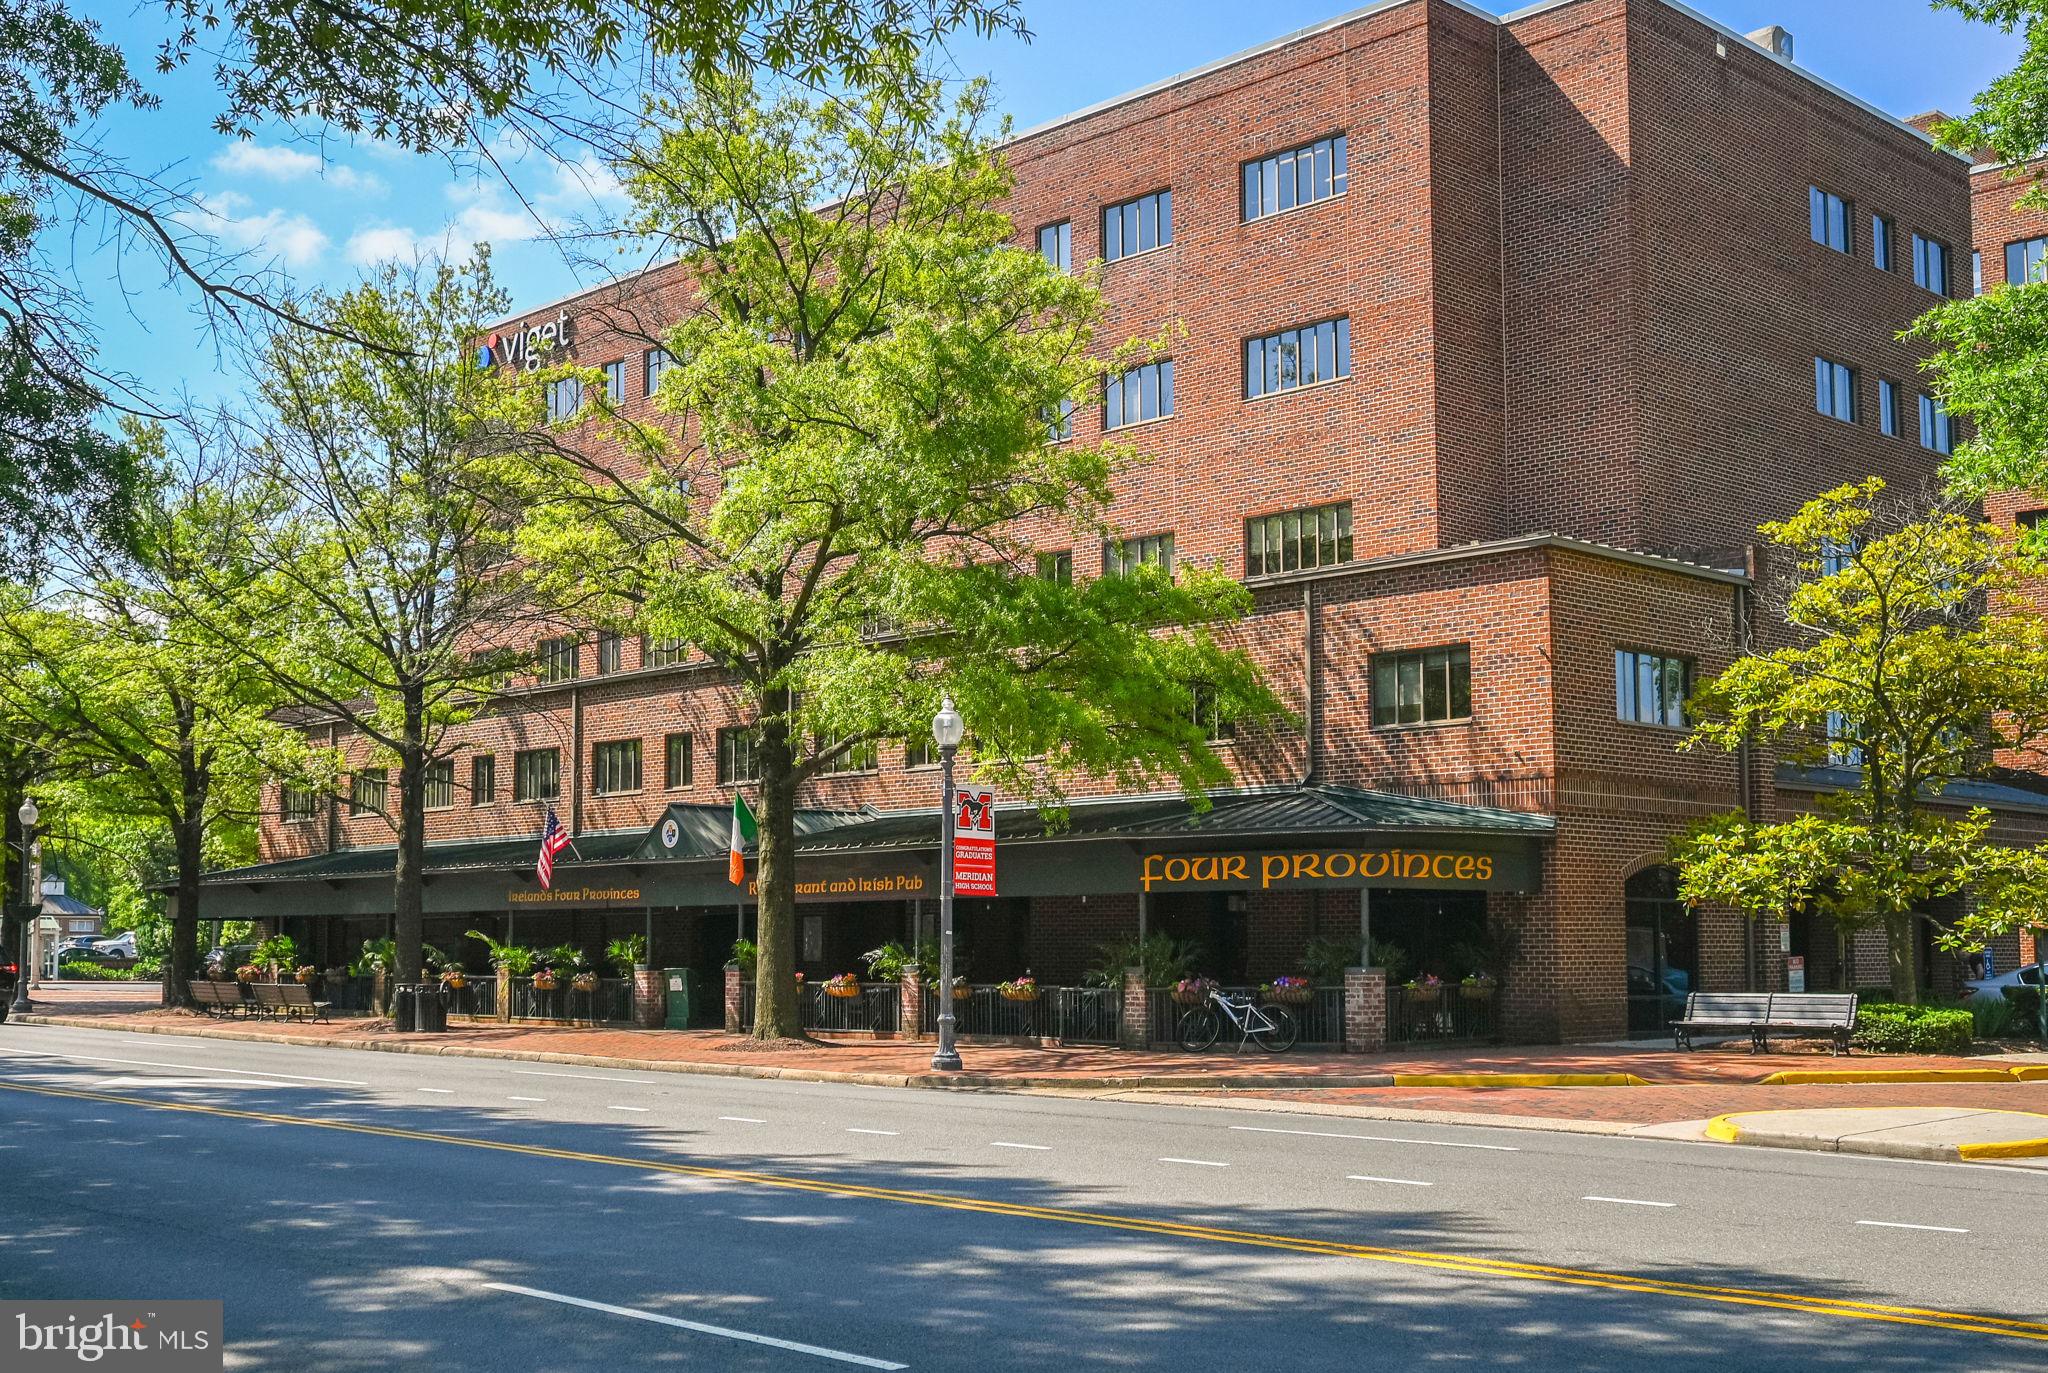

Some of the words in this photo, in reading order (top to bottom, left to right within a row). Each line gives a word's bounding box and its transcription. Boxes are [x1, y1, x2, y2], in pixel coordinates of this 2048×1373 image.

[502, 309, 569, 375] viget
[956, 851, 993, 860] GRADUATES
[955, 872, 993, 881] MERIDIAN
[830, 878, 857, 893] and
[859, 876, 893, 892] Irish
[896, 875, 923, 891] Pub
[970, 883, 994, 891] SCHOOL
[508, 889, 553, 903] Ireland's
[555, 888, 581, 901] Four
[582, 887, 640, 901] Provinces
